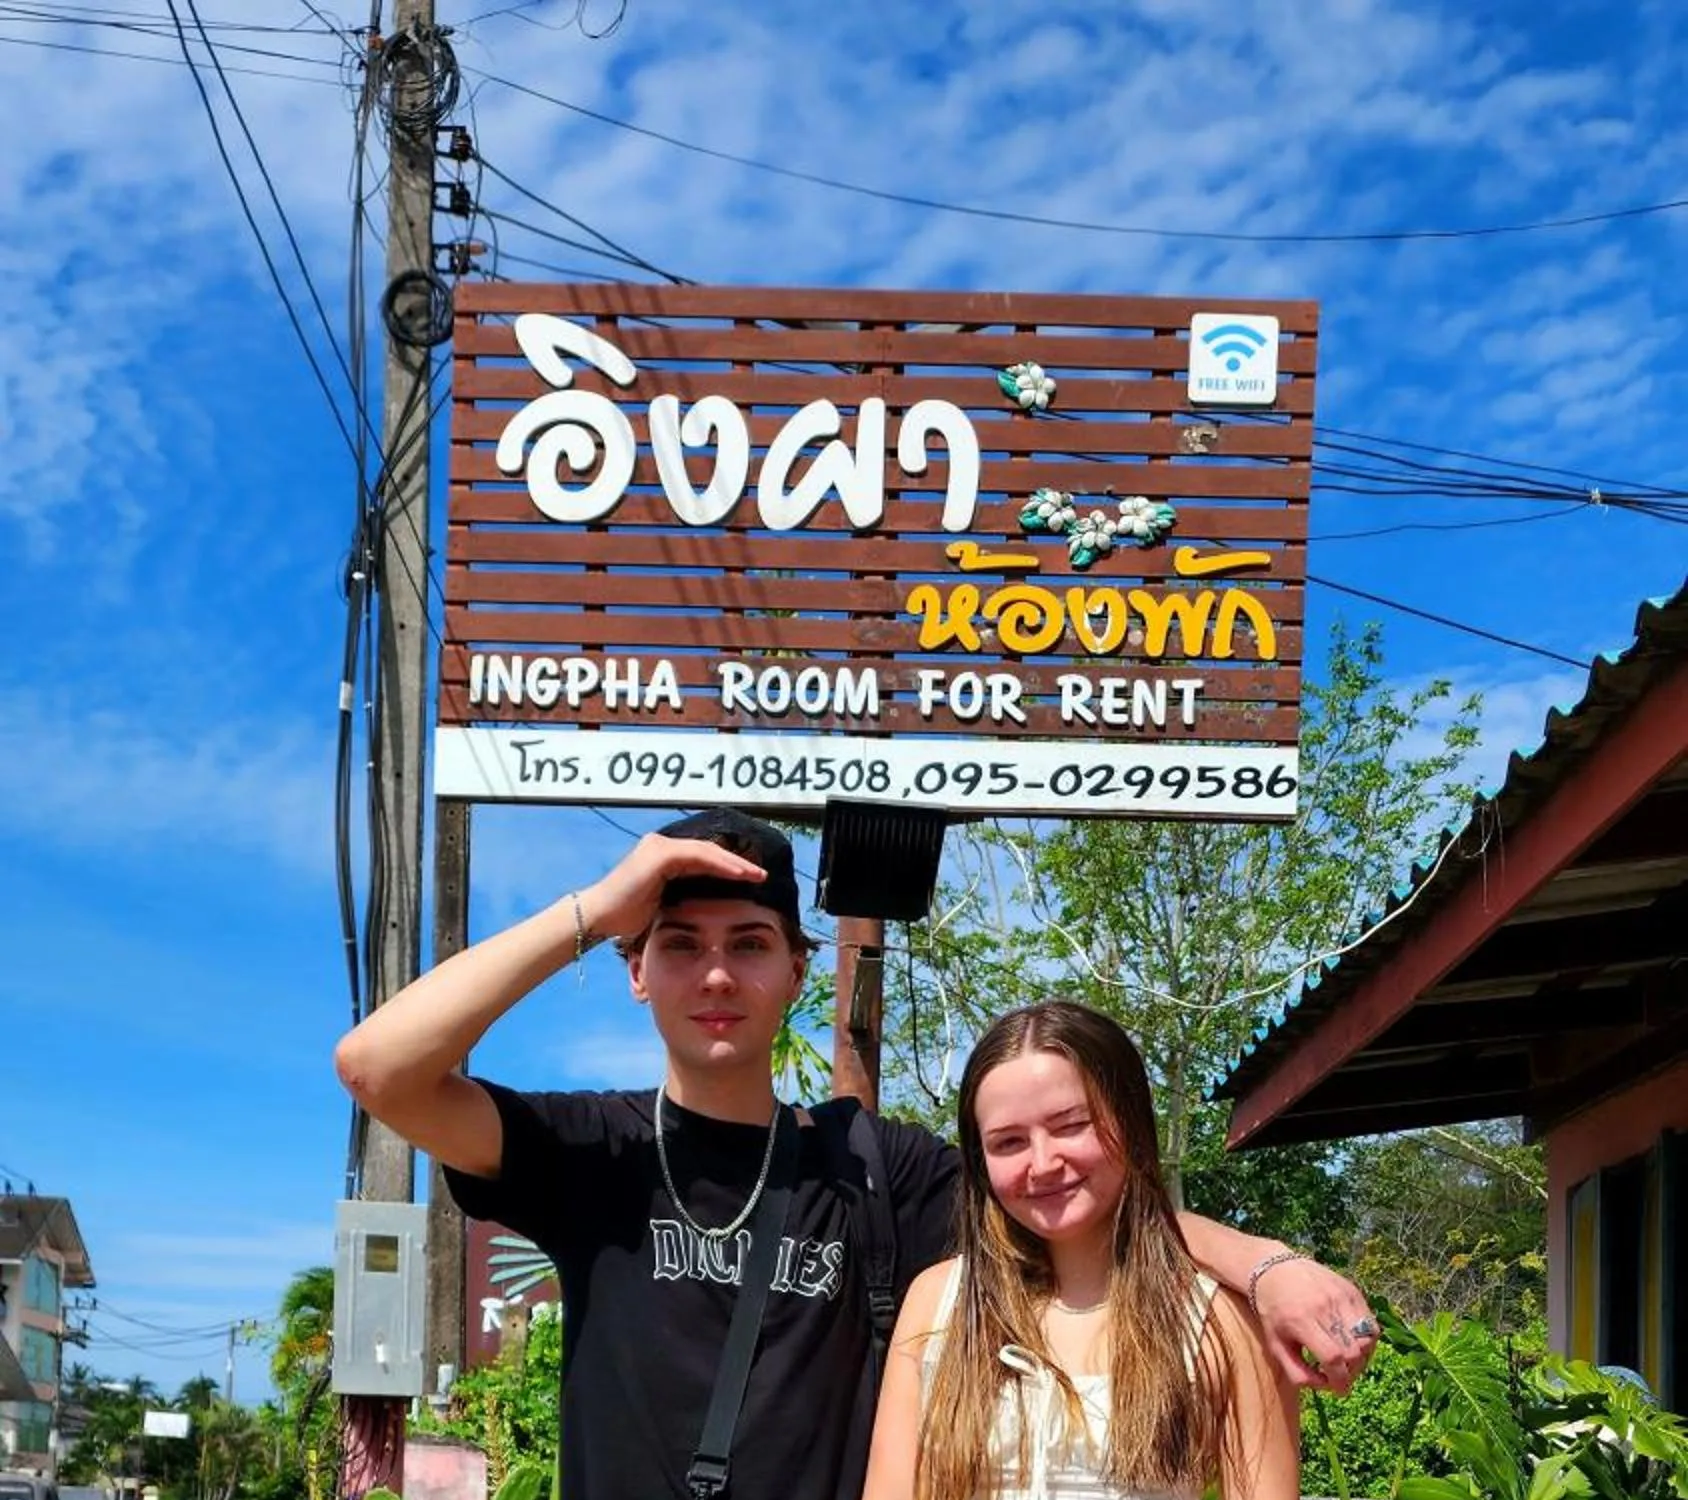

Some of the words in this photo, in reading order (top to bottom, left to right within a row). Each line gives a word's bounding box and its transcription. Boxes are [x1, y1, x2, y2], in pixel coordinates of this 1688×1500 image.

[1198, 377, 1229, 391] FREE
[496, 313, 981, 532] อิงผา
[905, 541, 1278, 662] ห้องพัก
[469, 653, 682, 711] INGPHA
[717, 660, 880, 717] ROOM
[917, 668, 1027, 724] FOR
[1056, 673, 1205, 727] RENT
[509, 738, 592, 785] โทร.
